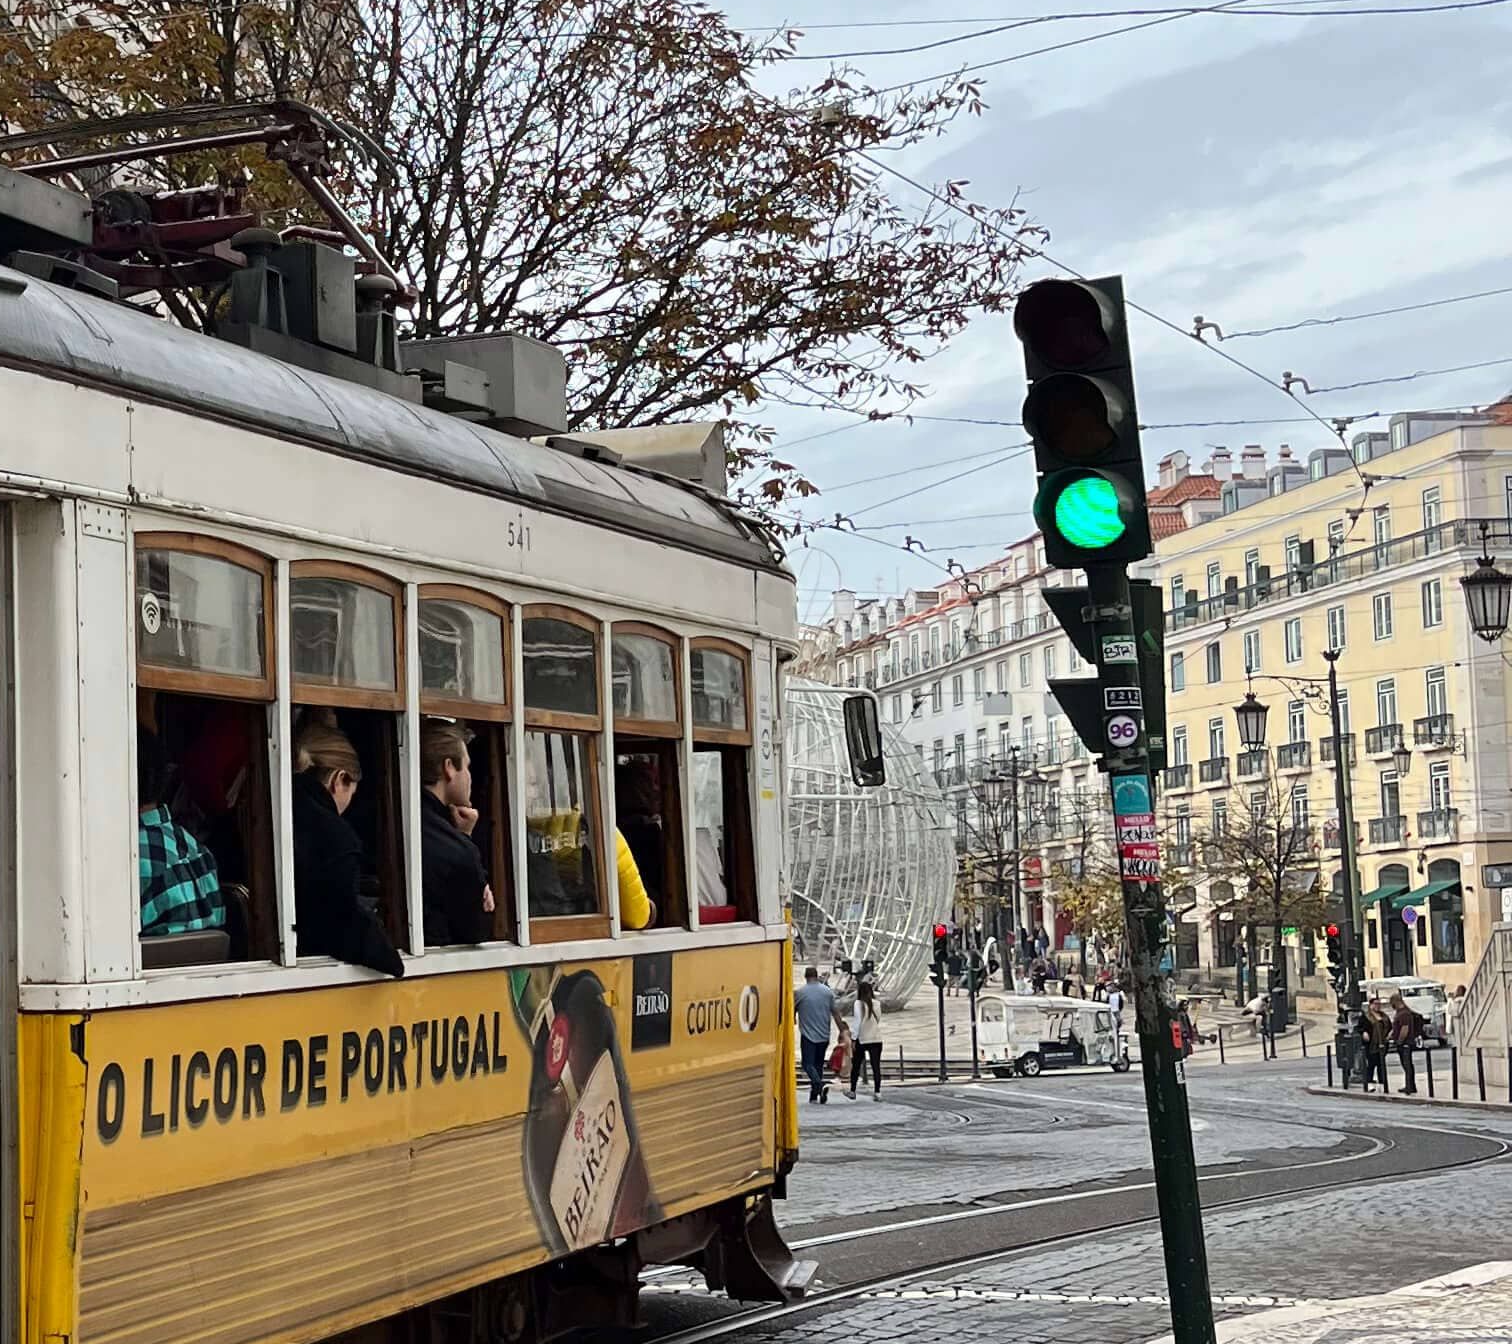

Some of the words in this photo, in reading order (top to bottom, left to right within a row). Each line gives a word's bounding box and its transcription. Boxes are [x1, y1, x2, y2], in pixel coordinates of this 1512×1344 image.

[507, 521, 531, 552] 541
[1109, 722, 1135, 739] 96
[686, 984, 732, 1036] carris
[96, 1062, 126, 1143] O
[141, 1043, 267, 1139] LICOR
[280, 1033, 330, 1115] DE
[340, 1011, 508, 1103] PORTUGAL
[565, 1099, 617, 1242] BEIRÃO
